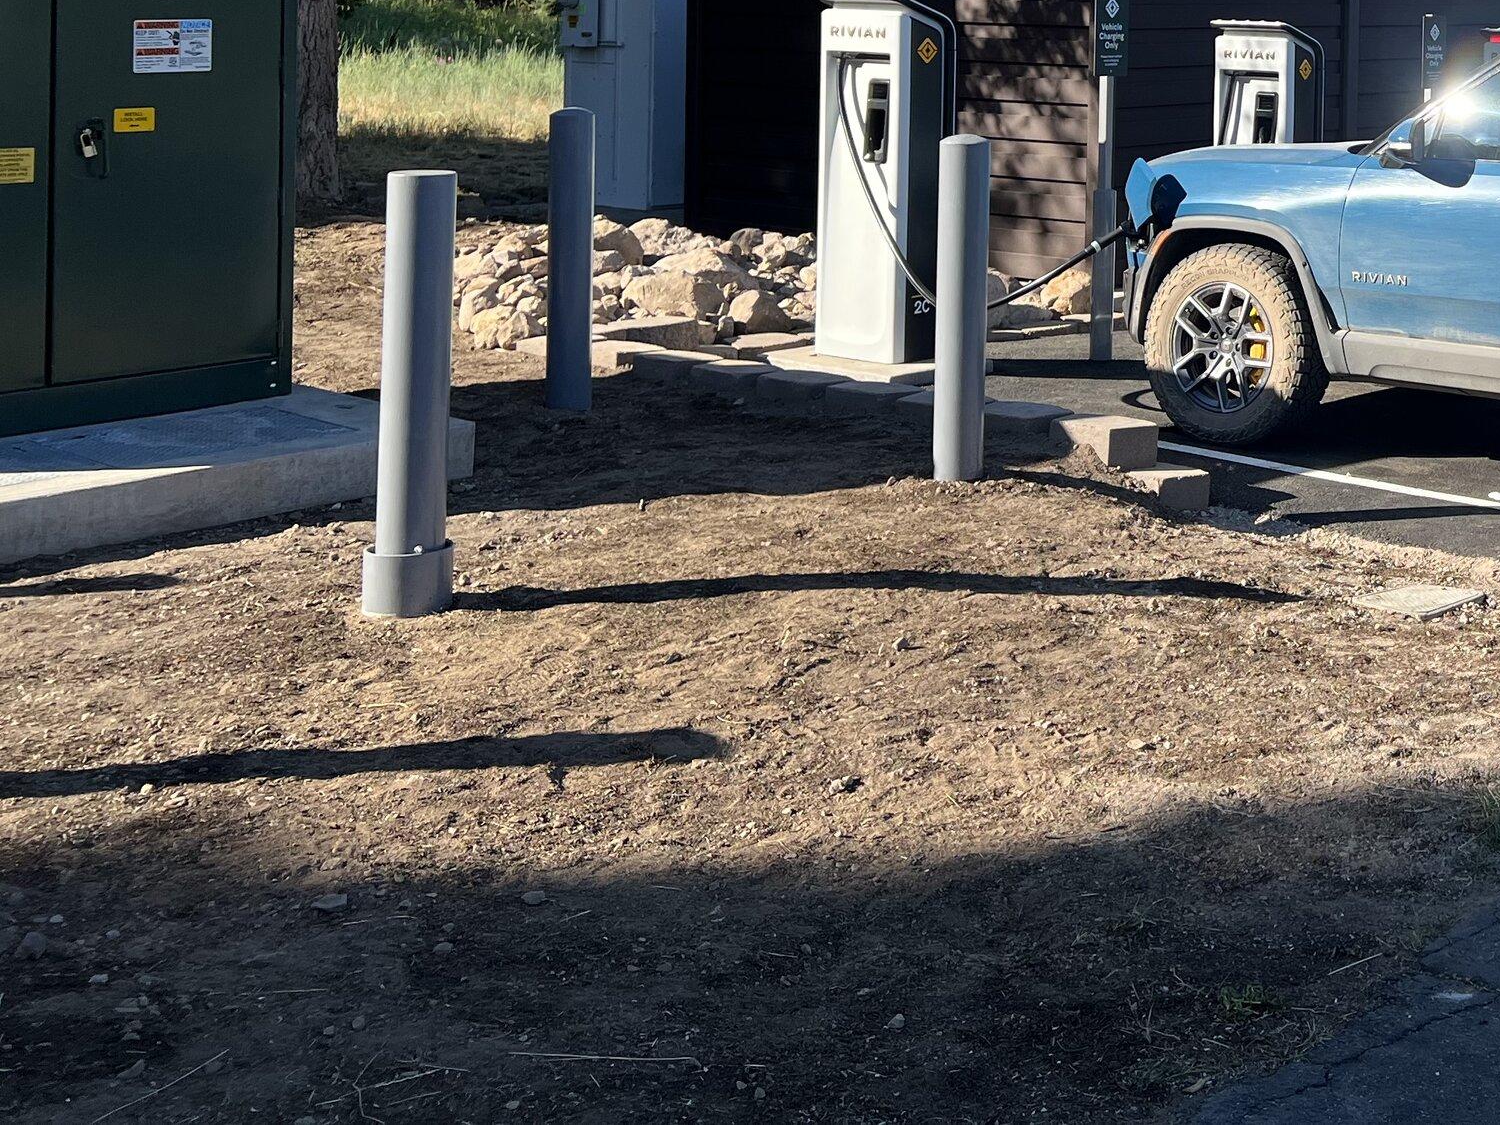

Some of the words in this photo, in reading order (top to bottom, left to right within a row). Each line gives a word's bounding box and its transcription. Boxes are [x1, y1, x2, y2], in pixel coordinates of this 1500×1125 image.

[830, 25, 886, 38] RIVIAN
[1101, 23, 1123, 31] Vehicle
[1099, 32, 1125, 41] Charging
[1104, 41, 1119, 50] Only
[1223, 49, 1276, 61] RIVIAN
[1351, 270, 1408, 286] RIVIAN
[913, 299, 930, 315] 2C
